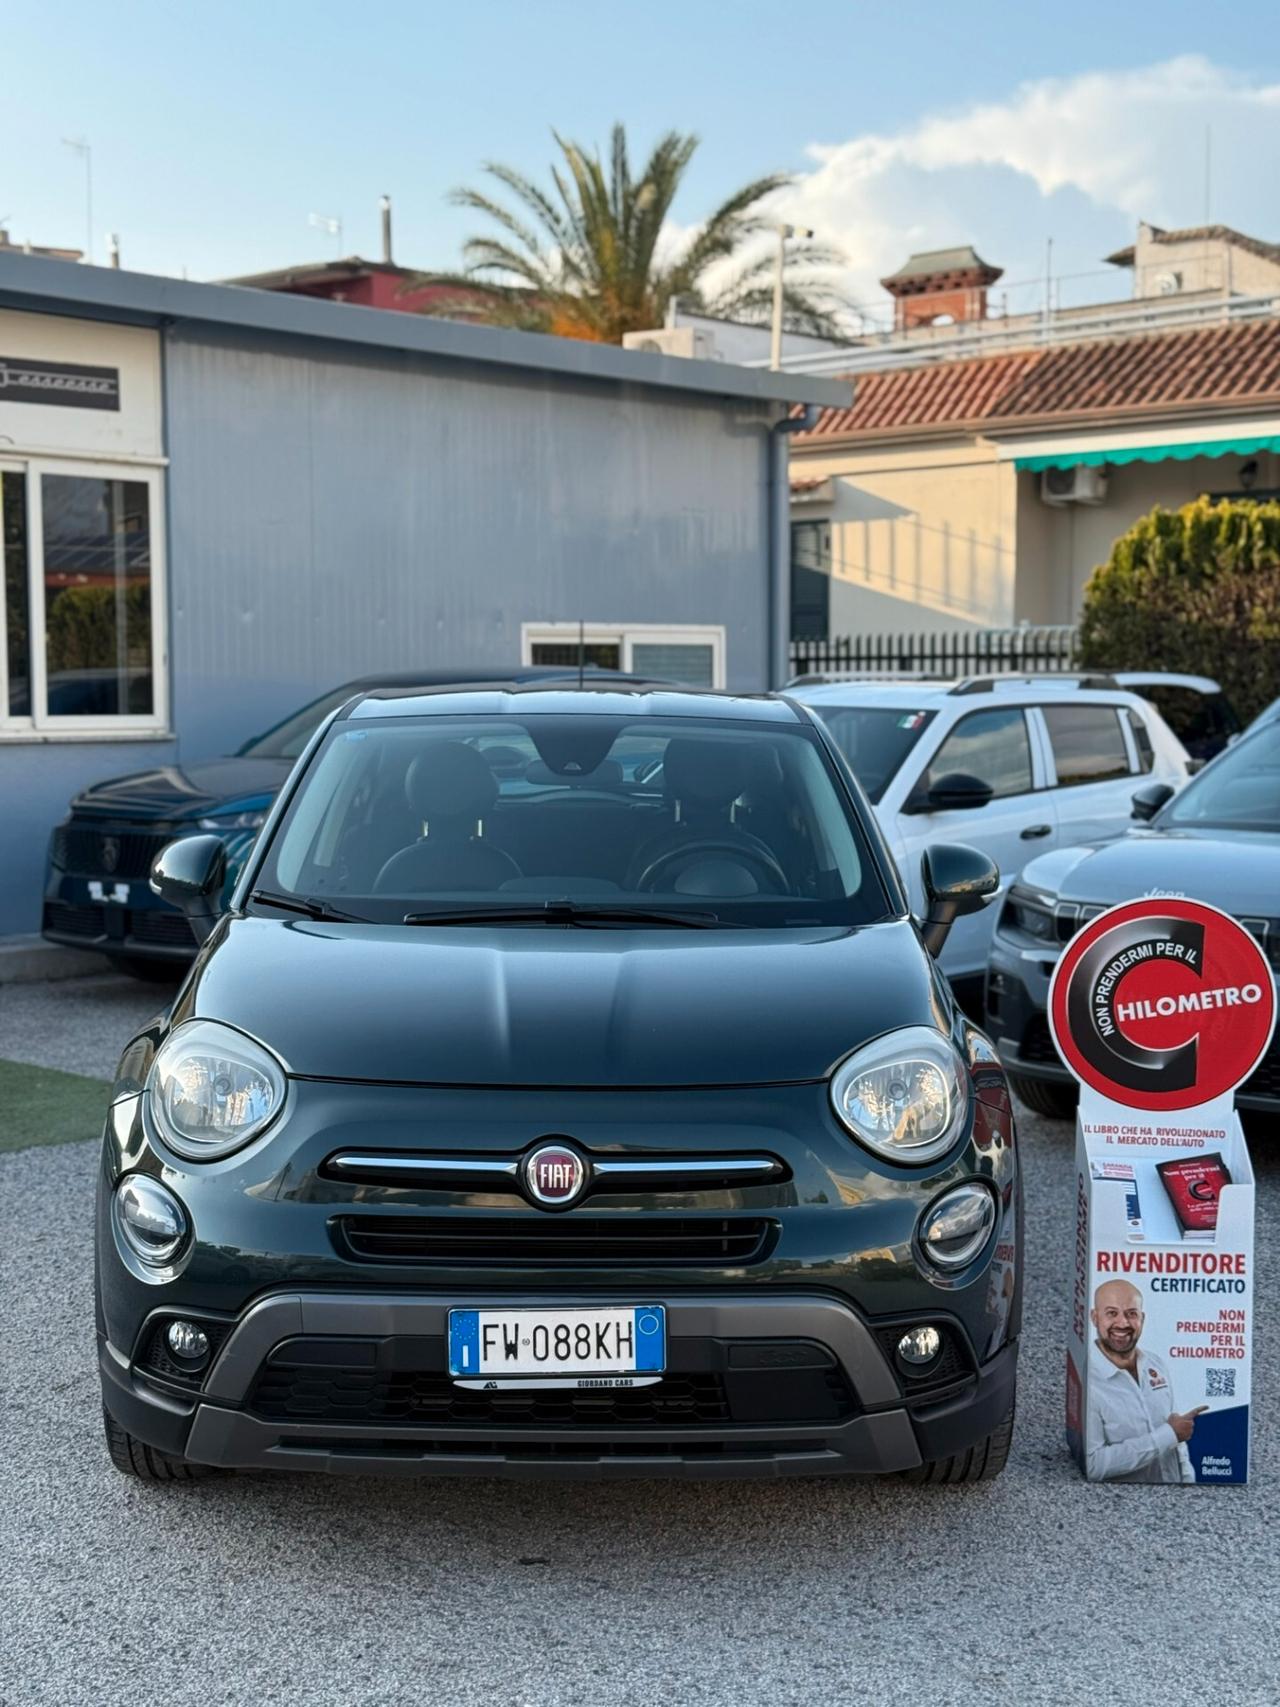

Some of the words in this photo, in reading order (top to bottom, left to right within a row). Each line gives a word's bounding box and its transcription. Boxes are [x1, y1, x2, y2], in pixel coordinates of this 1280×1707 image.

[1156, 942, 1185, 956] PER
[1186, 948, 1197, 965] IL
[1096, 943, 1153, 1004] PRENDERMI
[1096, 1007, 1115, 1037] NON
[1084, 1124, 1092, 1133] IL
[1093, 1124, 1119, 1134] LIBRO
[1120, 1126, 1138, 1135] CHE
[1139, 1127, 1153, 1136] HA
[1156, 1127, 1226, 1139] RIVOLUZIONATO
[1106, 1135, 1114, 1144] IL
[1117, 1136, 1158, 1146] MERCATO
[1160, 1137, 1205, 1148] DELL'AUTO
[540, 1163, 573, 1188] FIAT
[1096, 1251, 1246, 1275] RIVENDITORE
[1150, 1277, 1246, 1294] CERTIFICATO
[1219, 1309, 1246, 1321] NON
[1176, 1321, 1246, 1334] PRENDERMI
[1210, 1334, 1233, 1346] PER
[1235, 1335, 1246, 1346] IL
[1169, 1346, 1245, 1359] CHILOMETRO
[577, 1379, 613, 1388] GIORDANO
[614, 1378, 634, 1387] CARS
[1201, 1456, 1231, 1466] Alfredo
[1201, 1466, 1232, 1476] Bellucci
